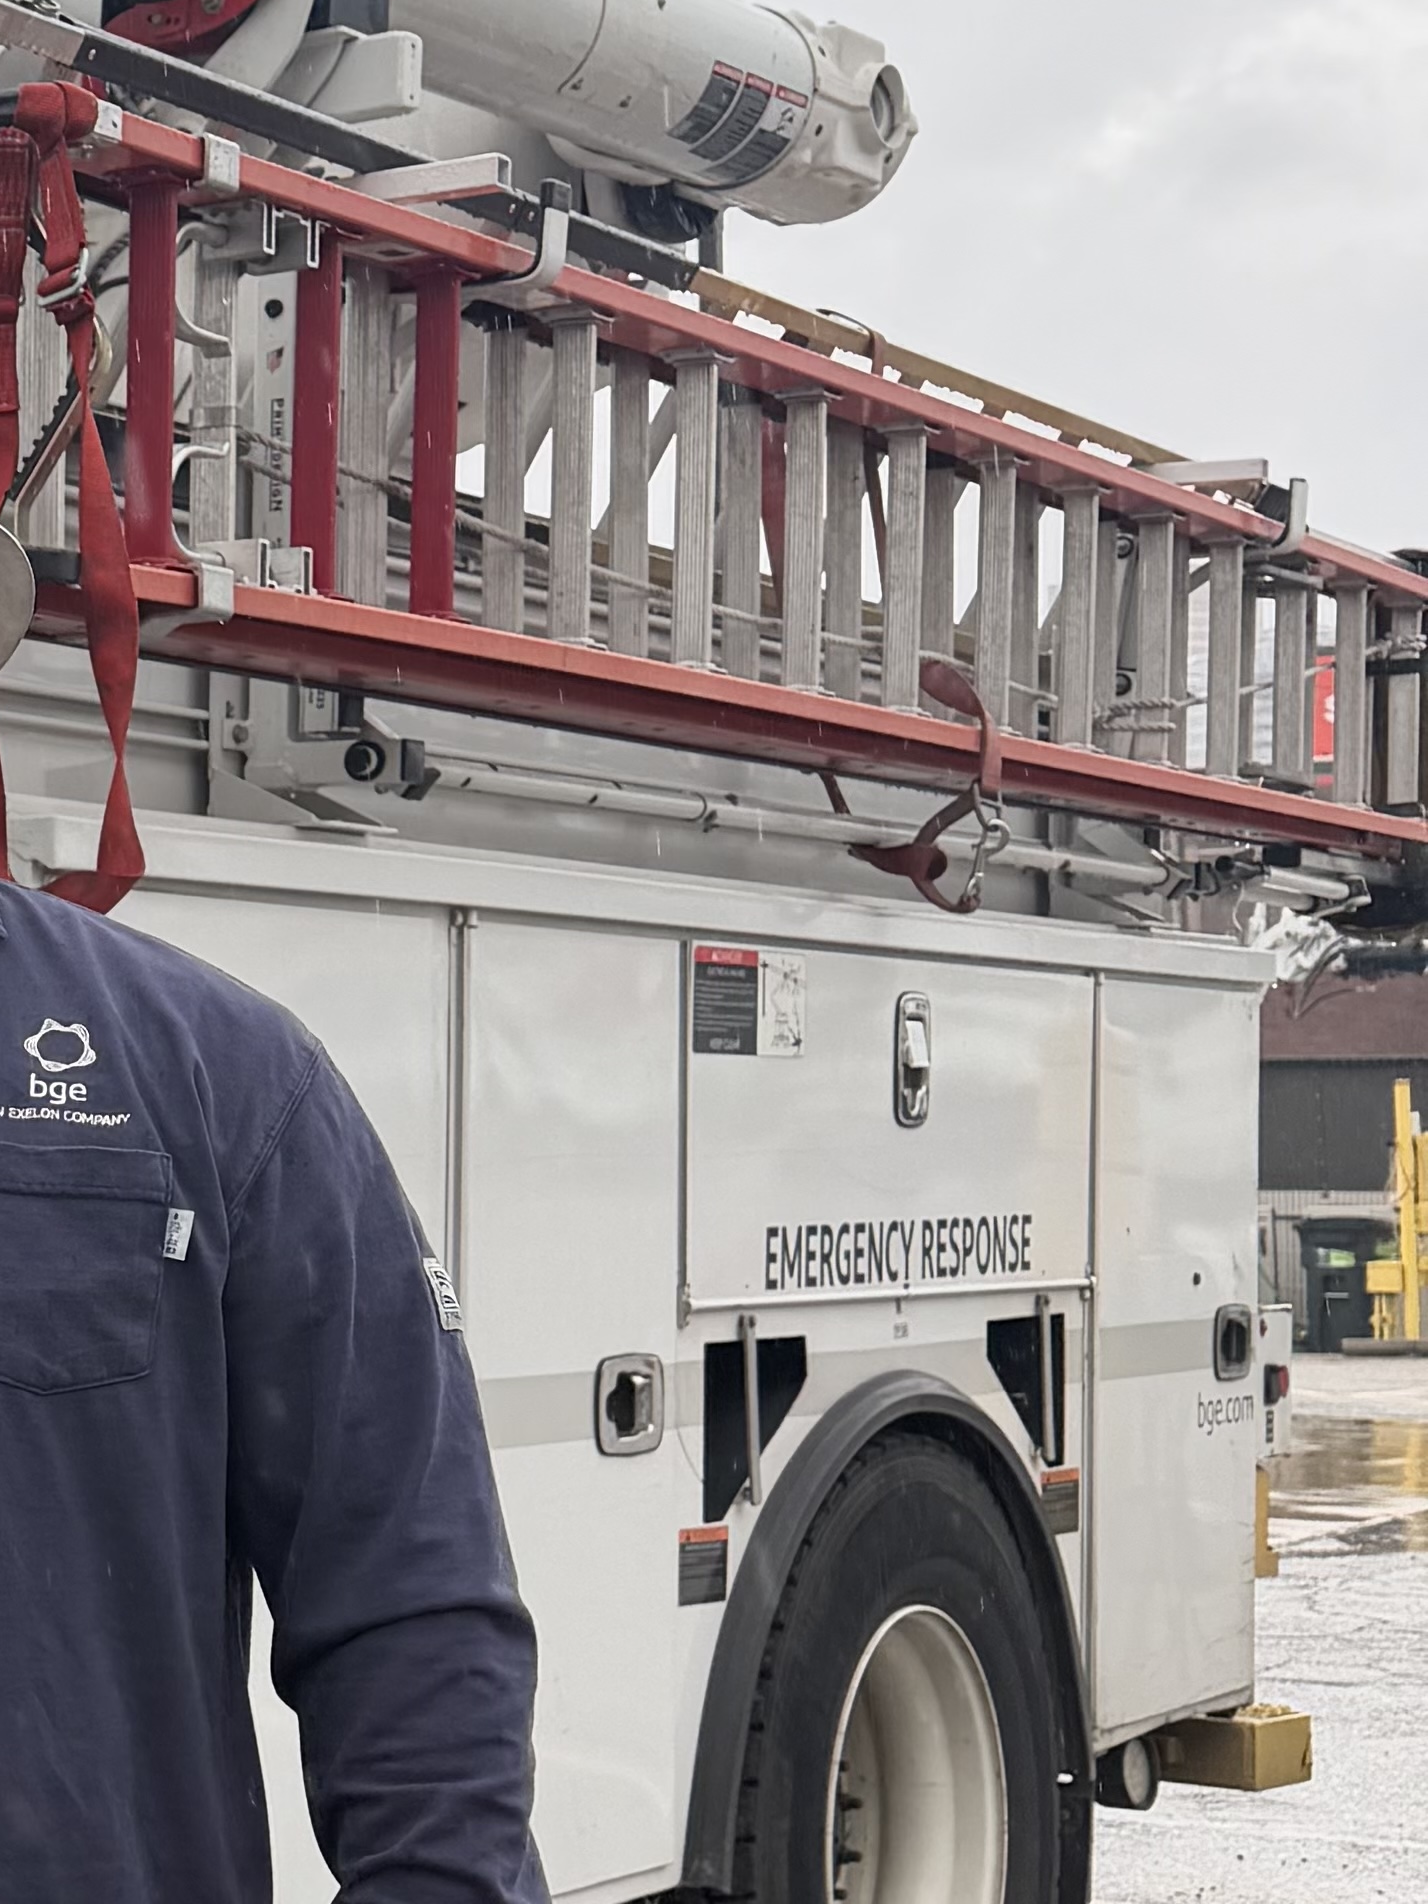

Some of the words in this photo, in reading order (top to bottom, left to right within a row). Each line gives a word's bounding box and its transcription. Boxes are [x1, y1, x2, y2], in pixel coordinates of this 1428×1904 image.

[29, 1072, 87, 1105] bge
[8, 1106, 60, 1120] EXELON
[63, 1109, 131, 1126] COMPANY
[764, 1220, 915, 1291] EMERGENCY
[921, 1214, 1034, 1280] RESPONSE
[1197, 1392, 1254, 1436] bge.com
